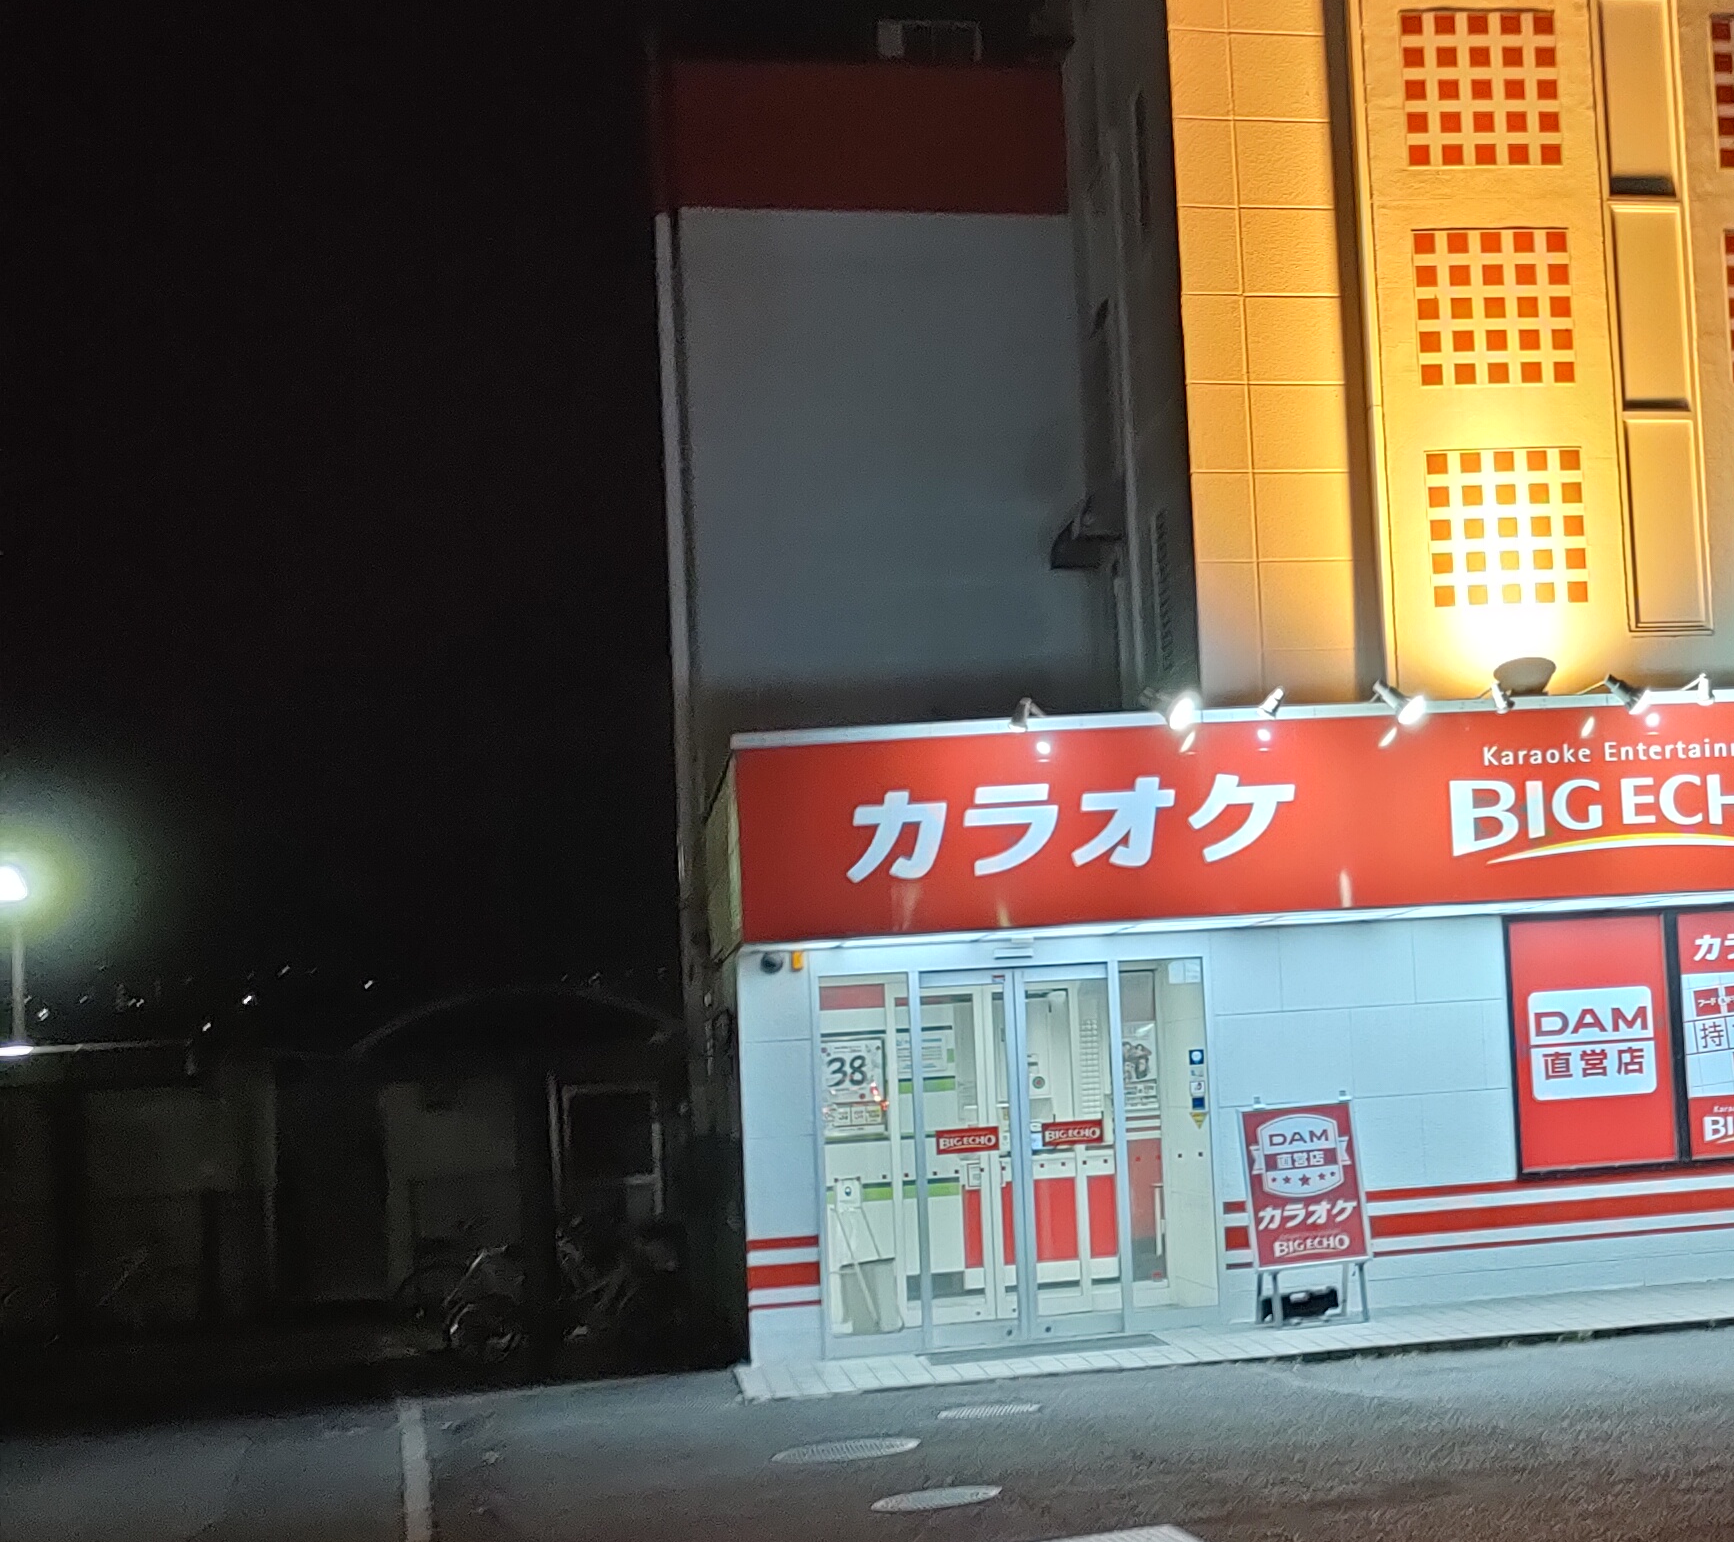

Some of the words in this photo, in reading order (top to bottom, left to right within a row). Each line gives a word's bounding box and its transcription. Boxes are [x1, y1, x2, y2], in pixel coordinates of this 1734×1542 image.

[1482, 741, 1592, 767] Karaoke
[846, 773, 1295, 883] カラオケ
[1448, 778, 1603, 857] BIG
[1534, 1004, 1650, 1037] DAM
[826, 1055, 867, 1088] 38
[1543, 1046, 1645, 1081] 直営店
[939, 1137, 963, 1150] BIG
[963, 1134, 997, 1146] ECHO
[1044, 1128, 1067, 1143] BIG
[1068, 1126, 1101, 1139] ECHO
[1268, 1129, 1329, 1147] DAM
[1276, 1151, 1325, 1169] 直営店
[1258, 1199, 1358, 1231] カラオケ
[1273, 1239, 1304, 1258] BIG
[1306, 1234, 1351, 1250] ECHO
